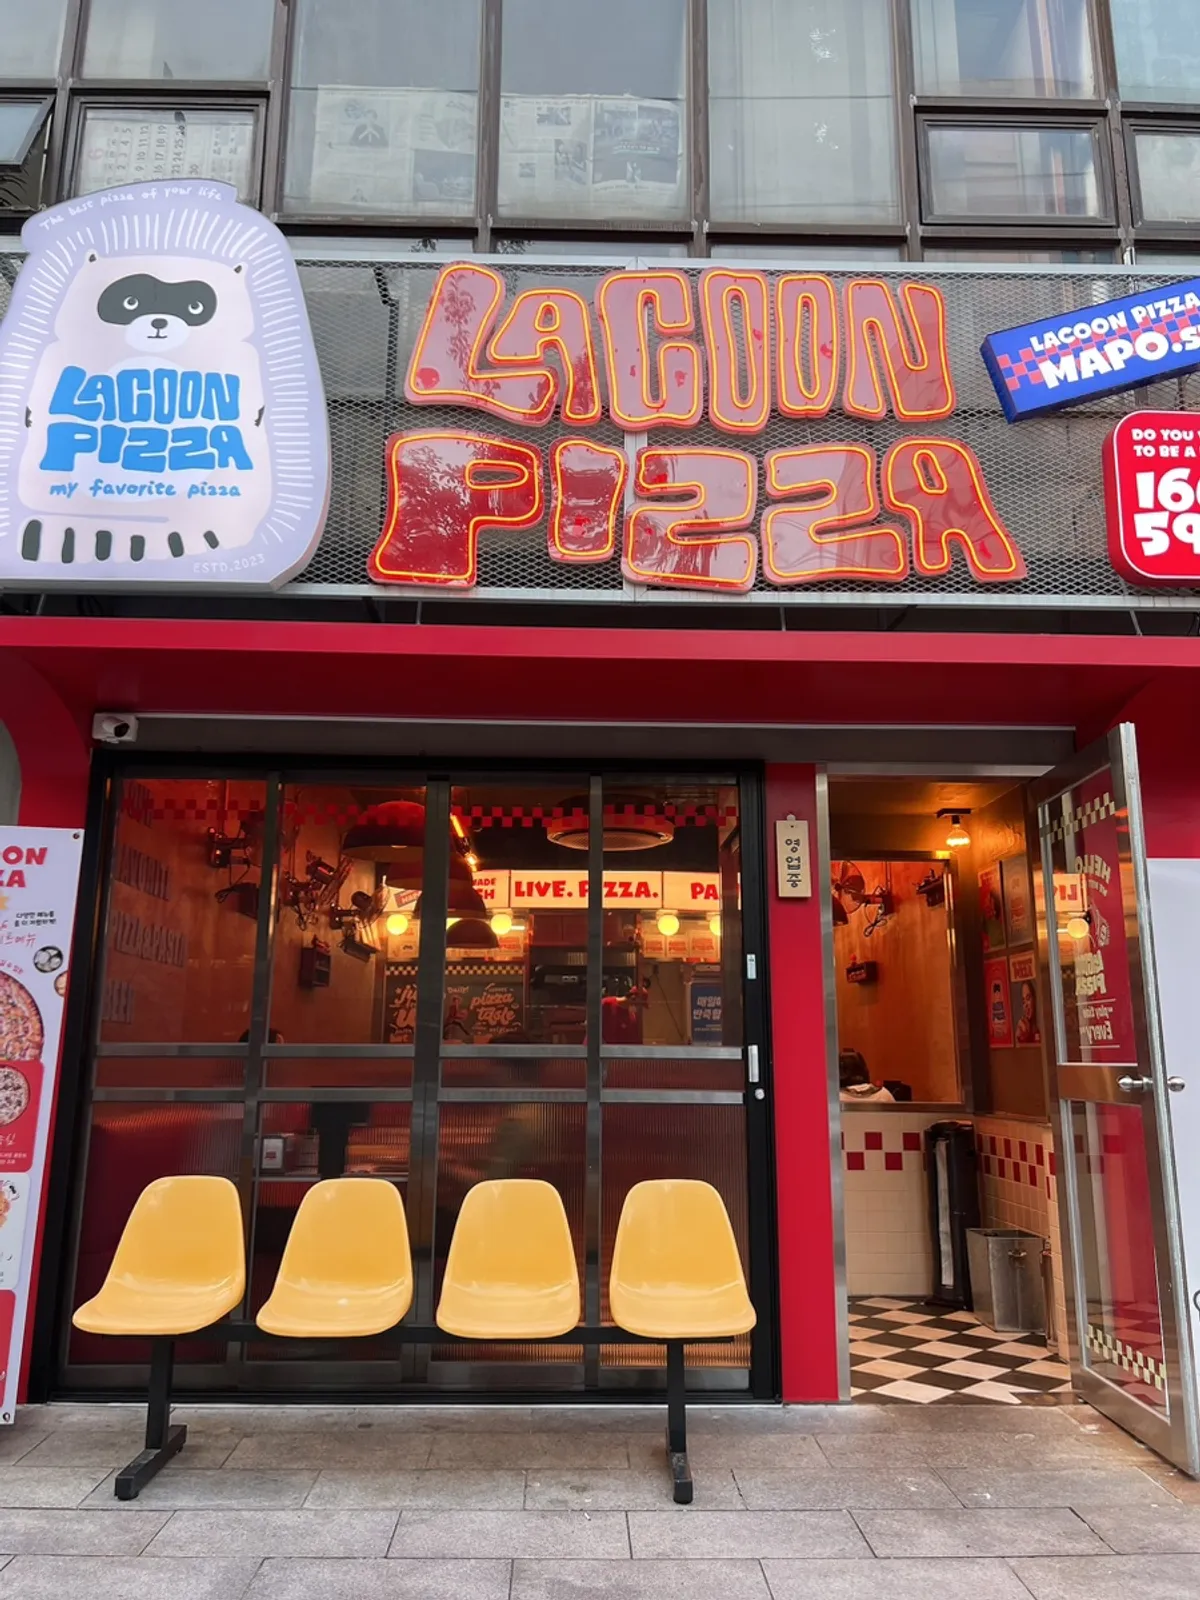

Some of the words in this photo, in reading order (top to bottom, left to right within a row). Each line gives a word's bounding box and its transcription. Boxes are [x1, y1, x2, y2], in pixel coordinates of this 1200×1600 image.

[69, 199, 94, 215] best
[141, 187, 158, 201] of
[164, 186, 193, 198] your
[198, 186, 223, 201] life
[1030, 311, 1128, 353] LACOON
[1130, 291, 1200, 325] PIZZA
[1038, 325, 1200, 390] MAPO.S
[39, 421, 254, 473] PIZZA
[1131, 428, 1157, 441] DO
[1160, 429, 1195, 442] YOU
[1133, 445, 1156, 457] TO
[1159, 445, 1180, 457] BE
[1184, 446, 1196, 458] A
[50, 482, 78, 498] my
[89, 479, 177, 497] favorite
[187, 481, 242, 499] pizza
[1135, 467, 1200, 513] 16
[367, 428, 1027, 594] PIZZA
[192, 553, 266, 574] ESTD.2023
[785, 838, 802, 888] 영업중
[515, 881, 573, 898] LIVE.
[579, 881, 659, 899] PZZA.
[690, 882, 721, 900] PA
